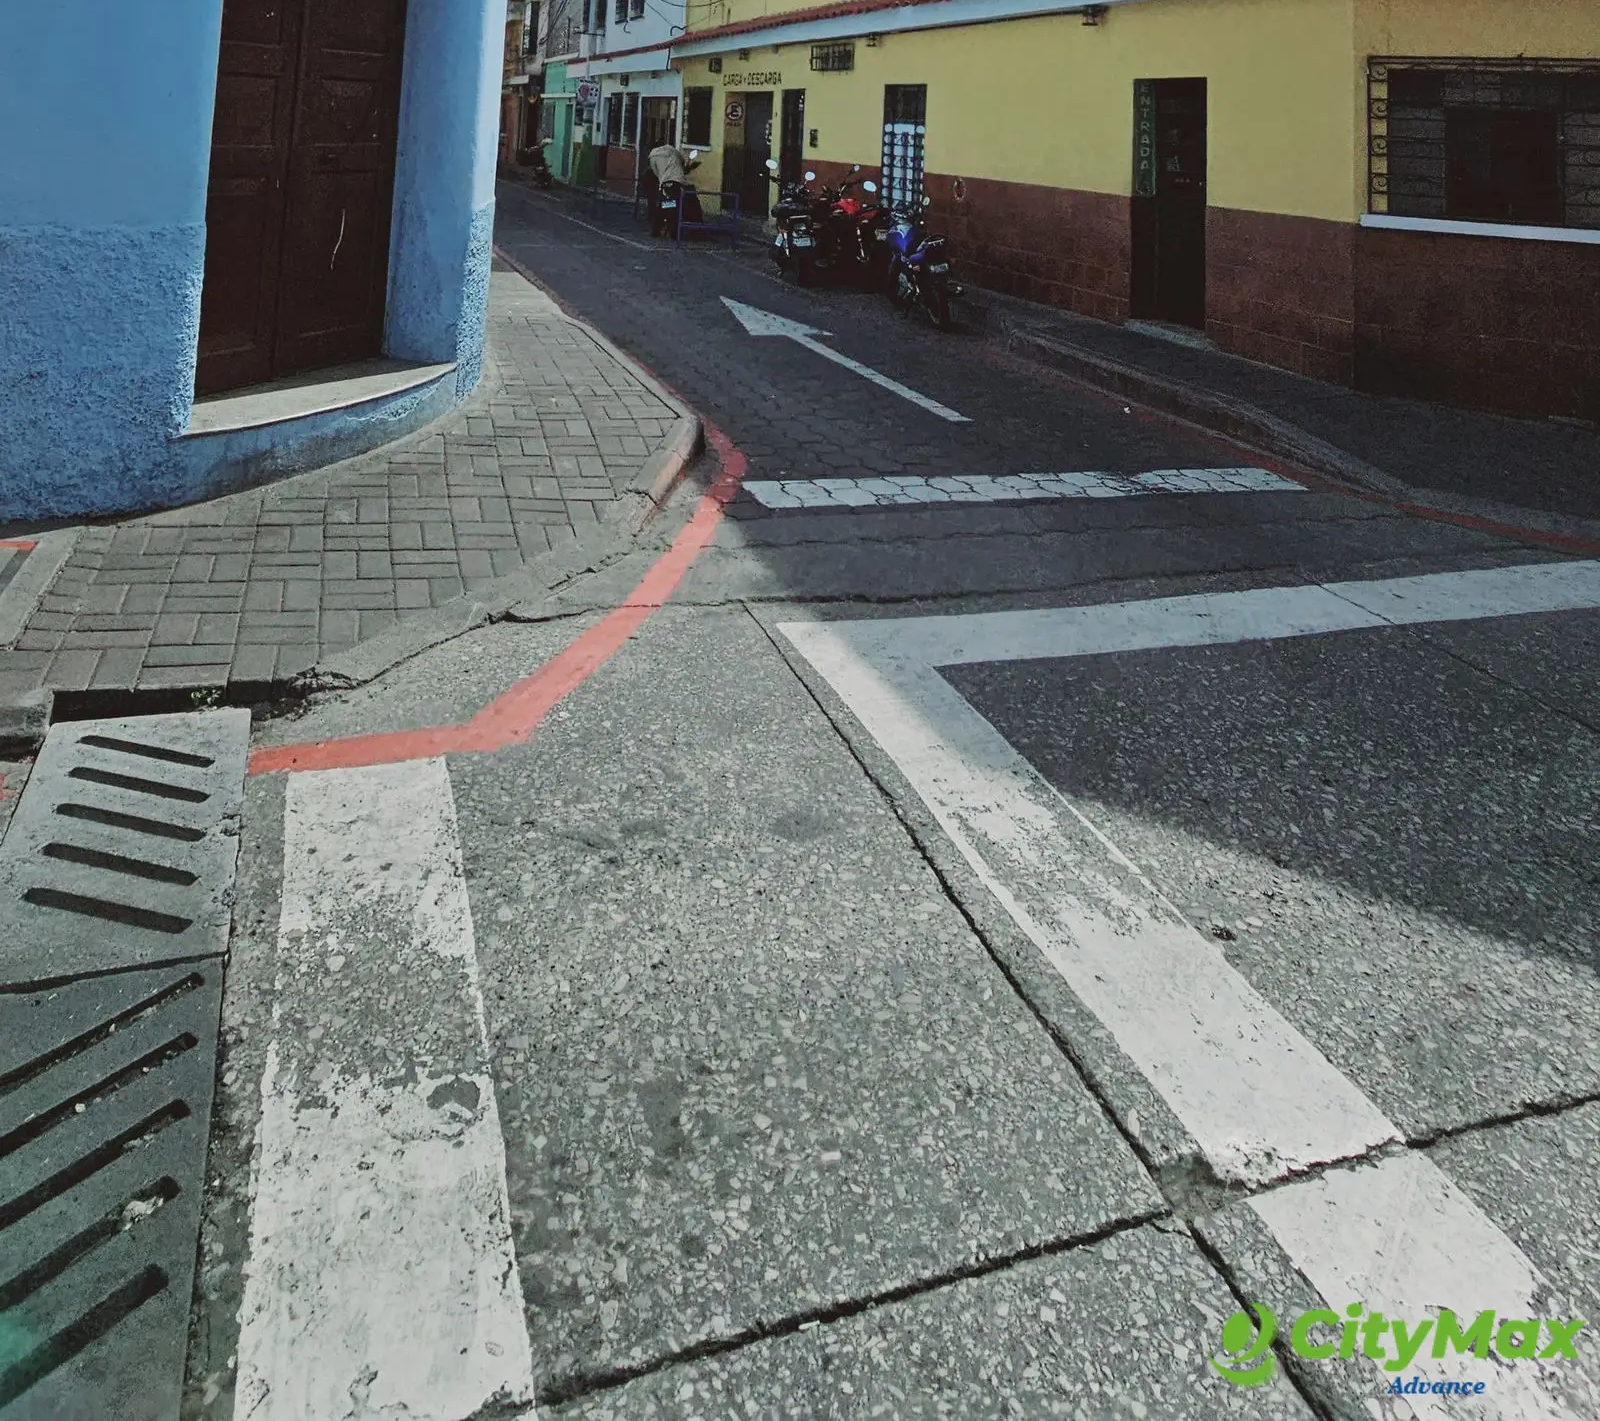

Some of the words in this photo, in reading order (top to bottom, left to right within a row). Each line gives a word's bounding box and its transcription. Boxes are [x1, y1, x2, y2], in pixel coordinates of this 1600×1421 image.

[723, 73, 743, 86] CARGA
[747, 71, 782, 85] DESCARGA
[1139, 82, 1151, 172] ENTRADA
